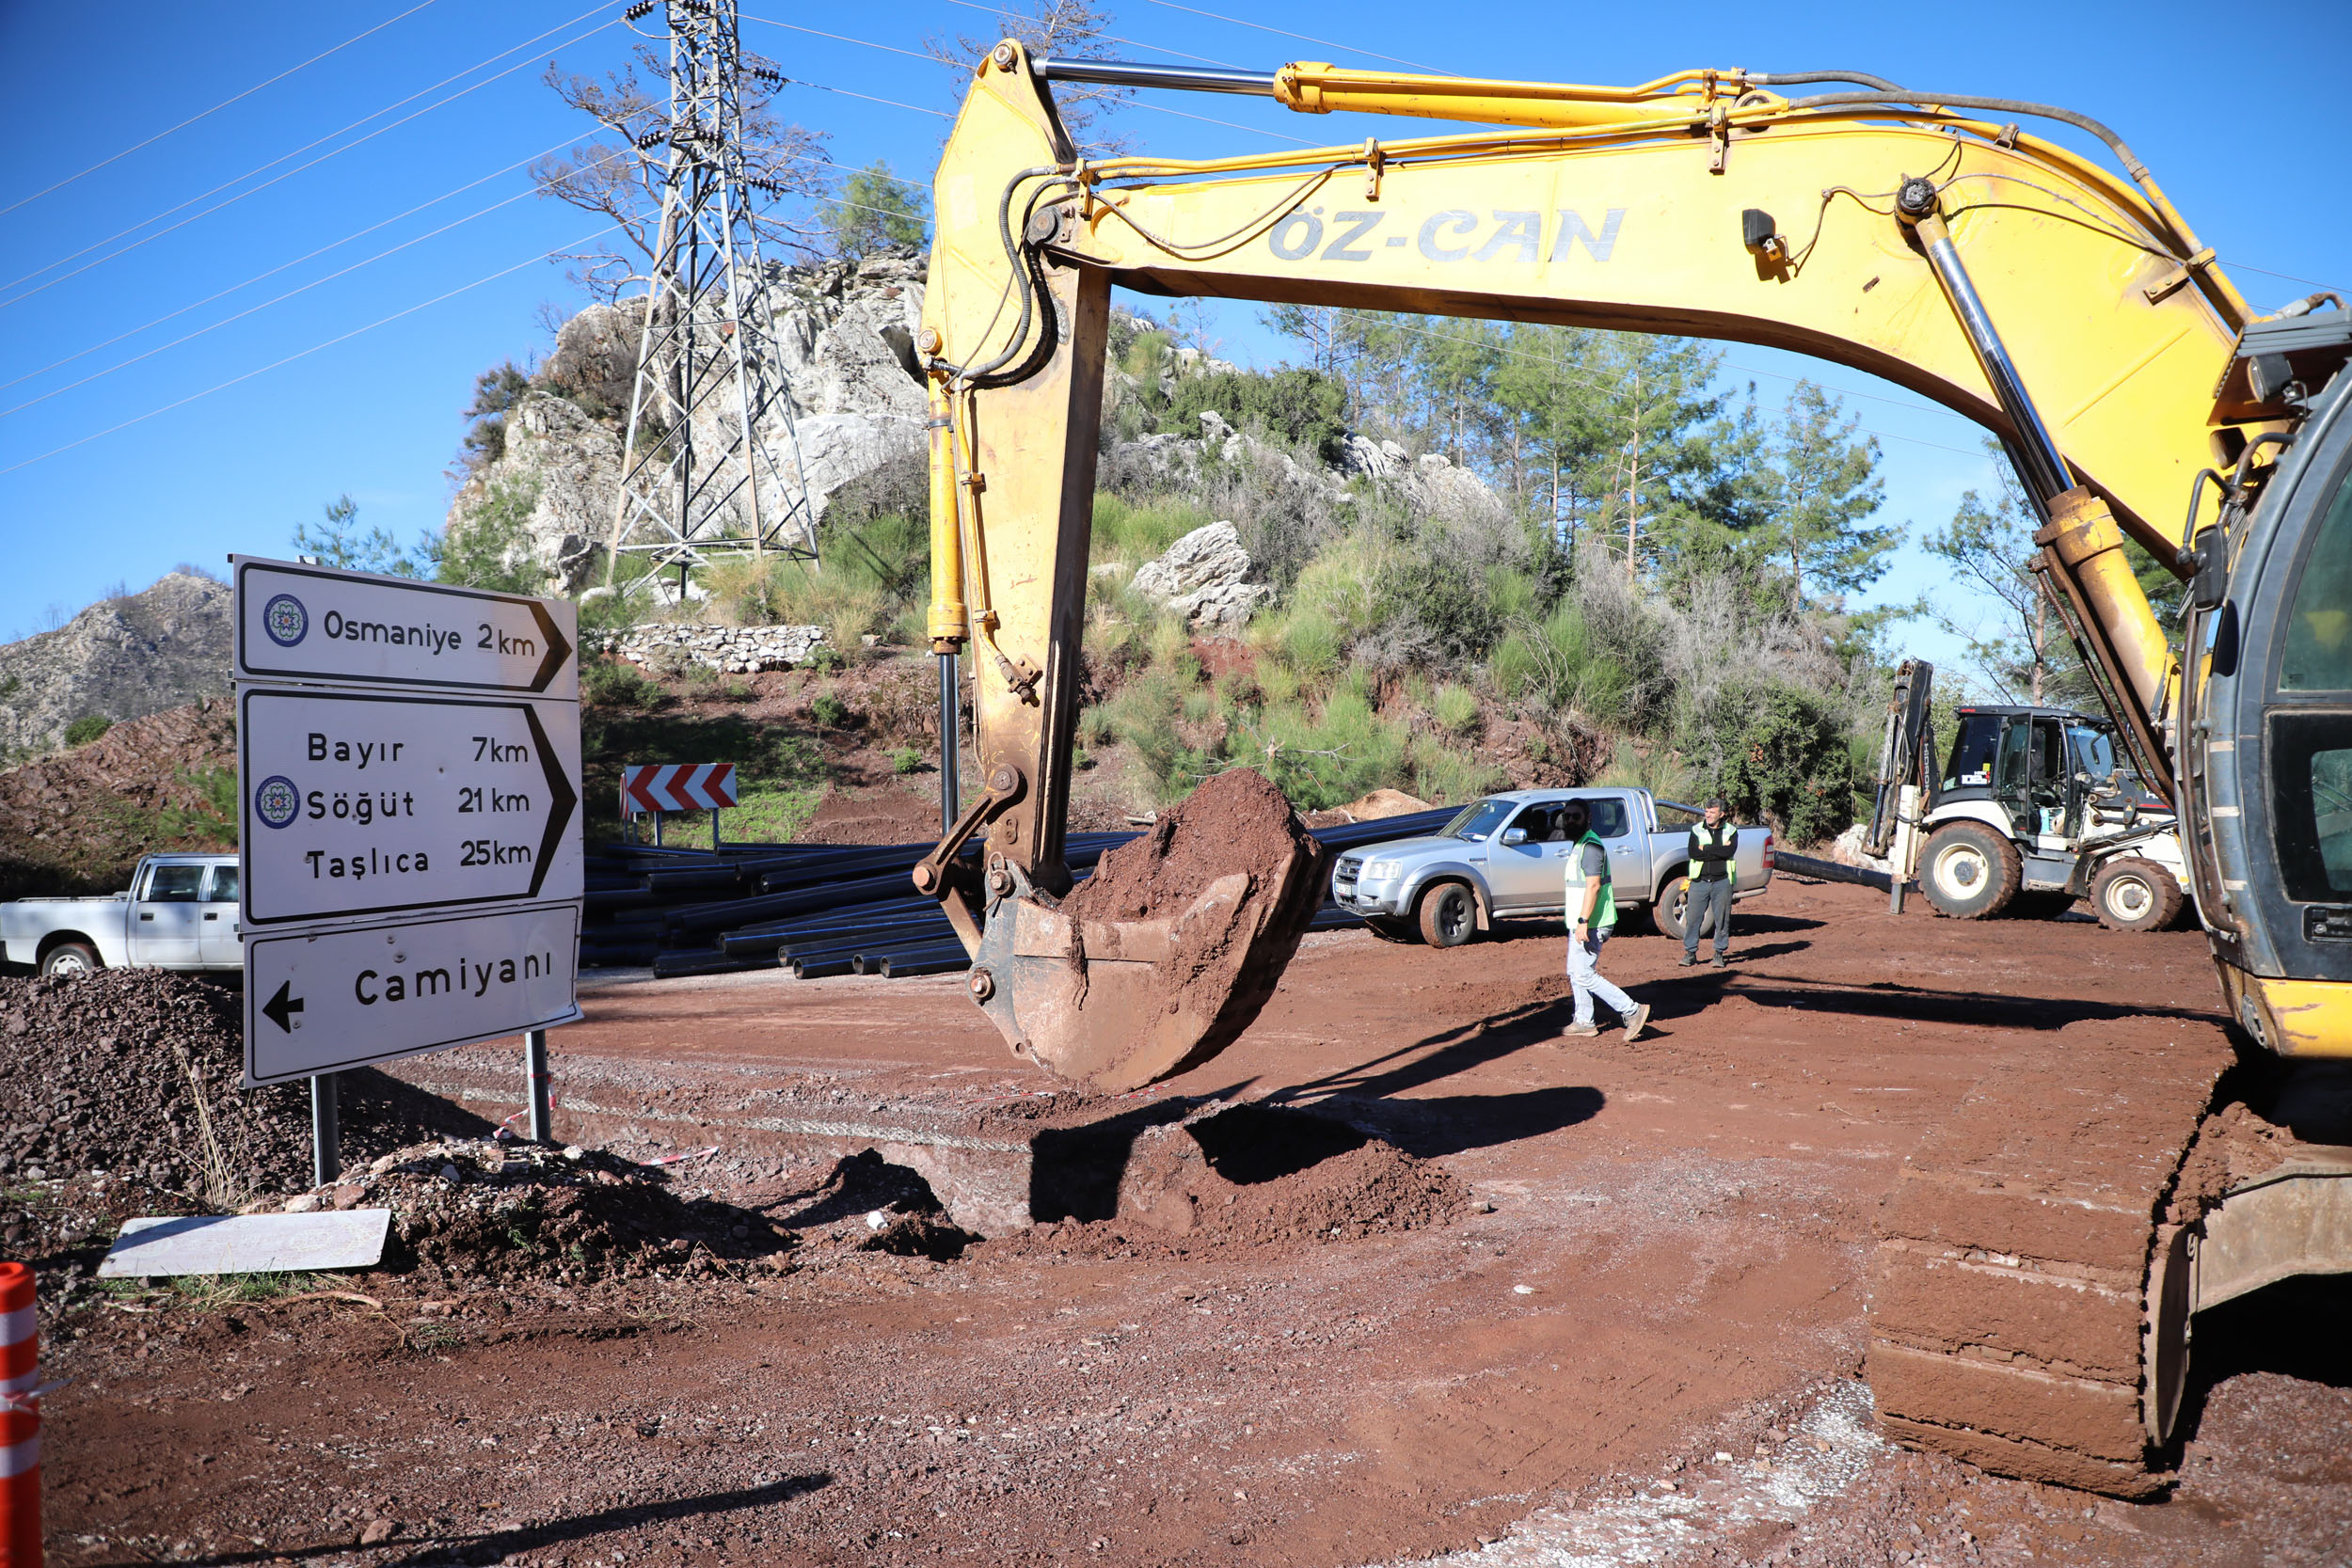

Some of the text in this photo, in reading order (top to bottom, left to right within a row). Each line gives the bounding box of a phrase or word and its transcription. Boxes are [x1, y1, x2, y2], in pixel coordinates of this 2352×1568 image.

[1268, 203, 1626, 263] ÖZ-CAN
[324, 610, 535, 657] Osmaniye 2 km
[308, 733, 405, 769] Bayır
[307, 790, 414, 826] Söğüt
[306, 847, 429, 880] Taşlıca
[355, 952, 550, 1006] Camiyanı
